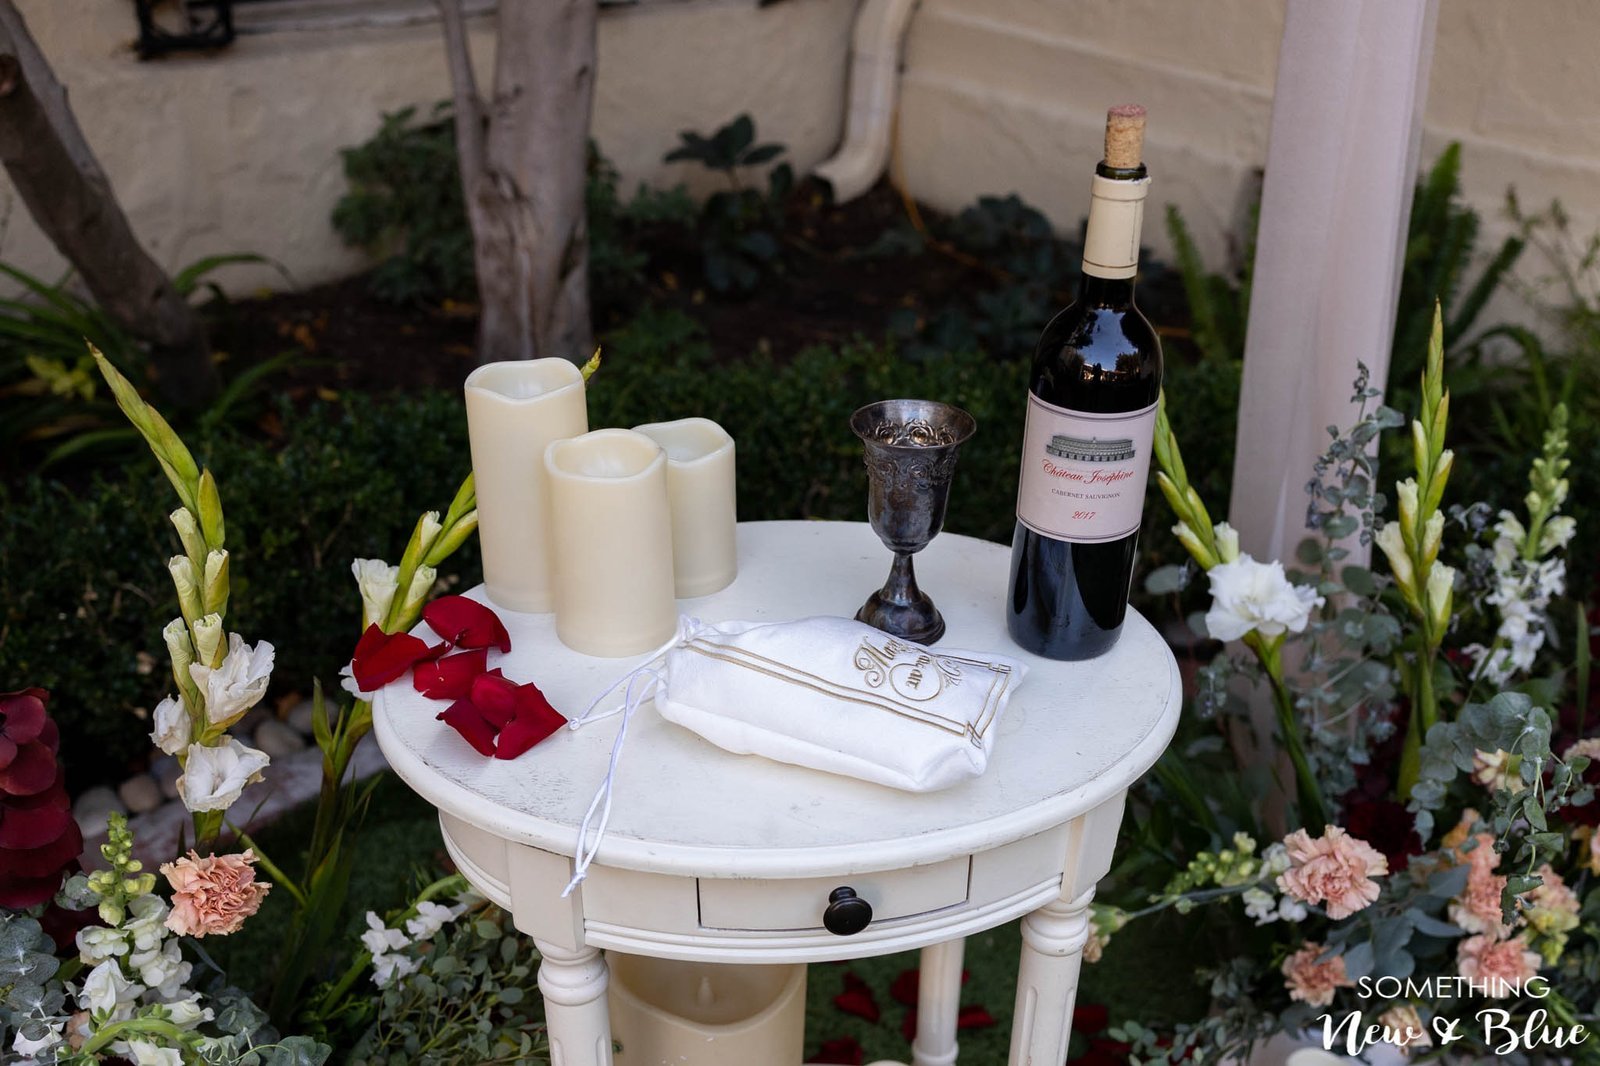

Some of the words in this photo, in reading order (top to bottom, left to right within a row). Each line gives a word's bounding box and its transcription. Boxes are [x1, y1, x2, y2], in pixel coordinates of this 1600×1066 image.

[1051, 488, 1083, 499] CABERNET
[1085, 491, 1120, 500] SAUVIGNON
[1072, 510, 1096, 520] 2017
